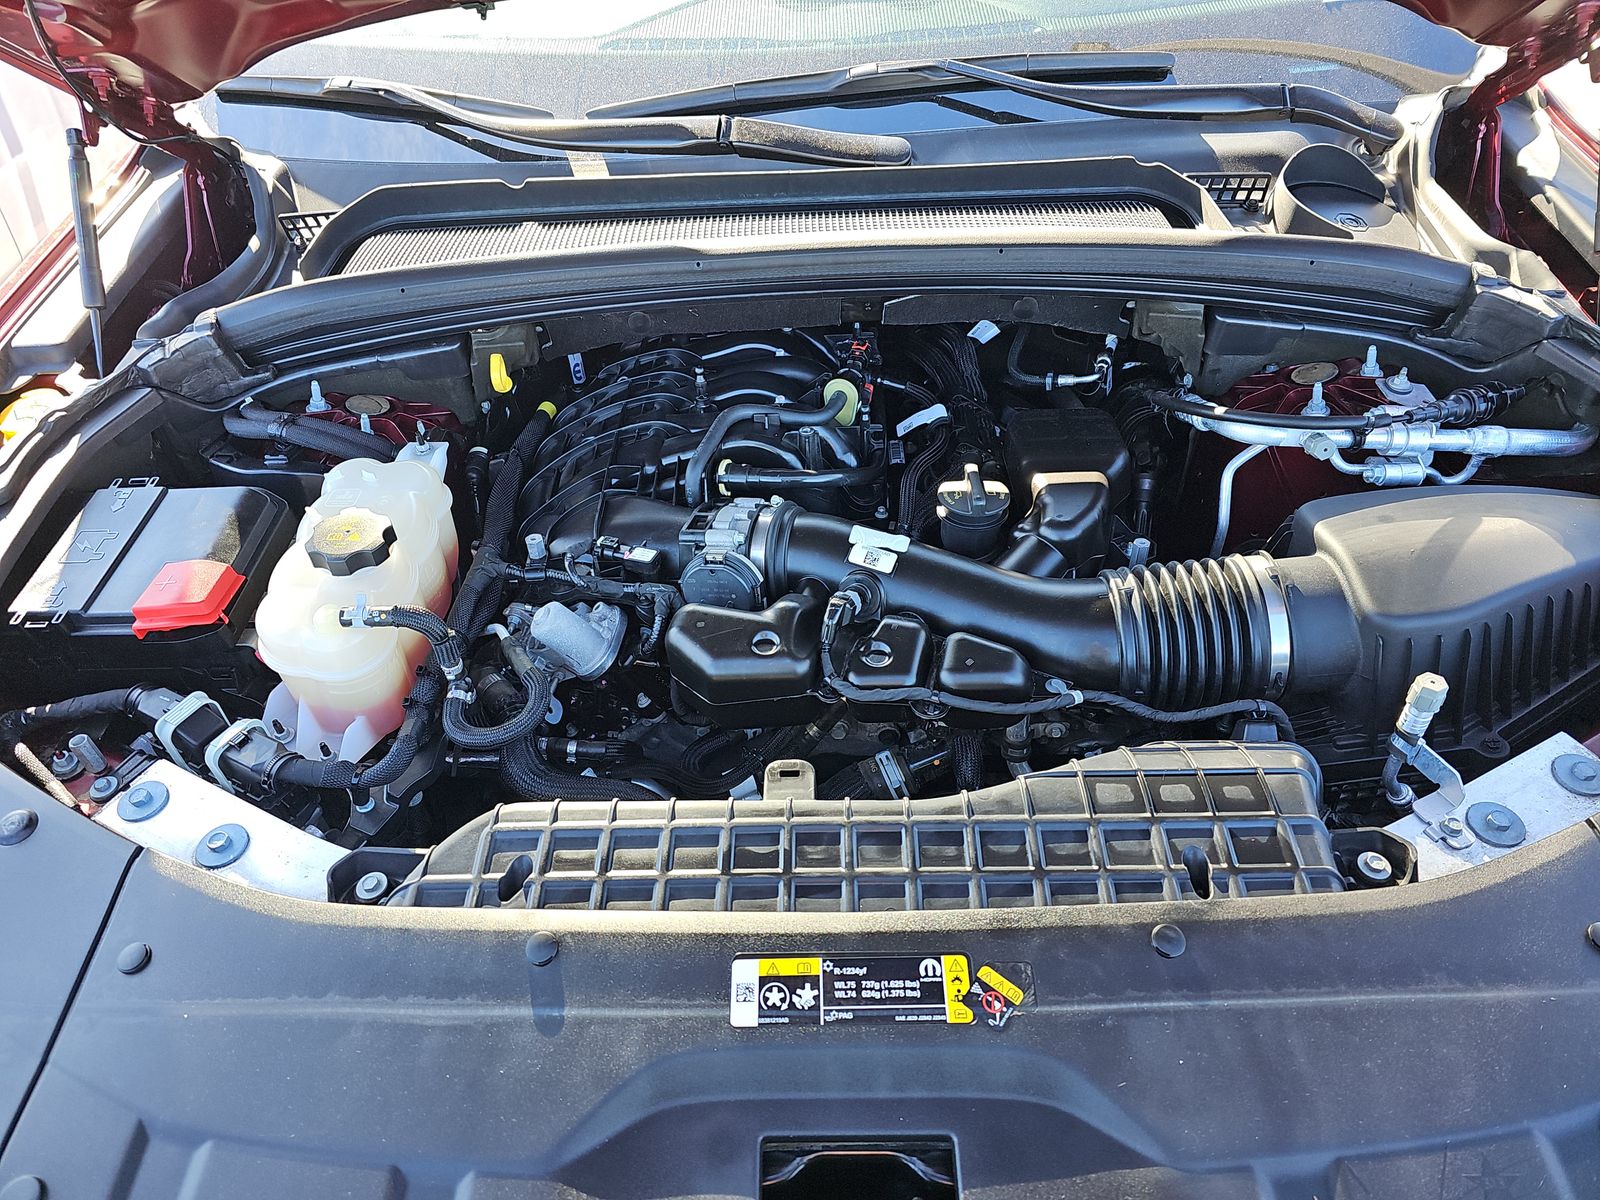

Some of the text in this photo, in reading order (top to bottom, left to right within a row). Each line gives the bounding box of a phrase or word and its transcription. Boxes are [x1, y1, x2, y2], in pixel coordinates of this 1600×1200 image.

[833, 966, 867, 977] R-1234yf
[833, 979, 920, 990] WL75 737g (1.625 lbs)
[834, 989, 921, 999] WL74 624g (1.375 lbs)
[838, 1012, 854, 1020] PAG
